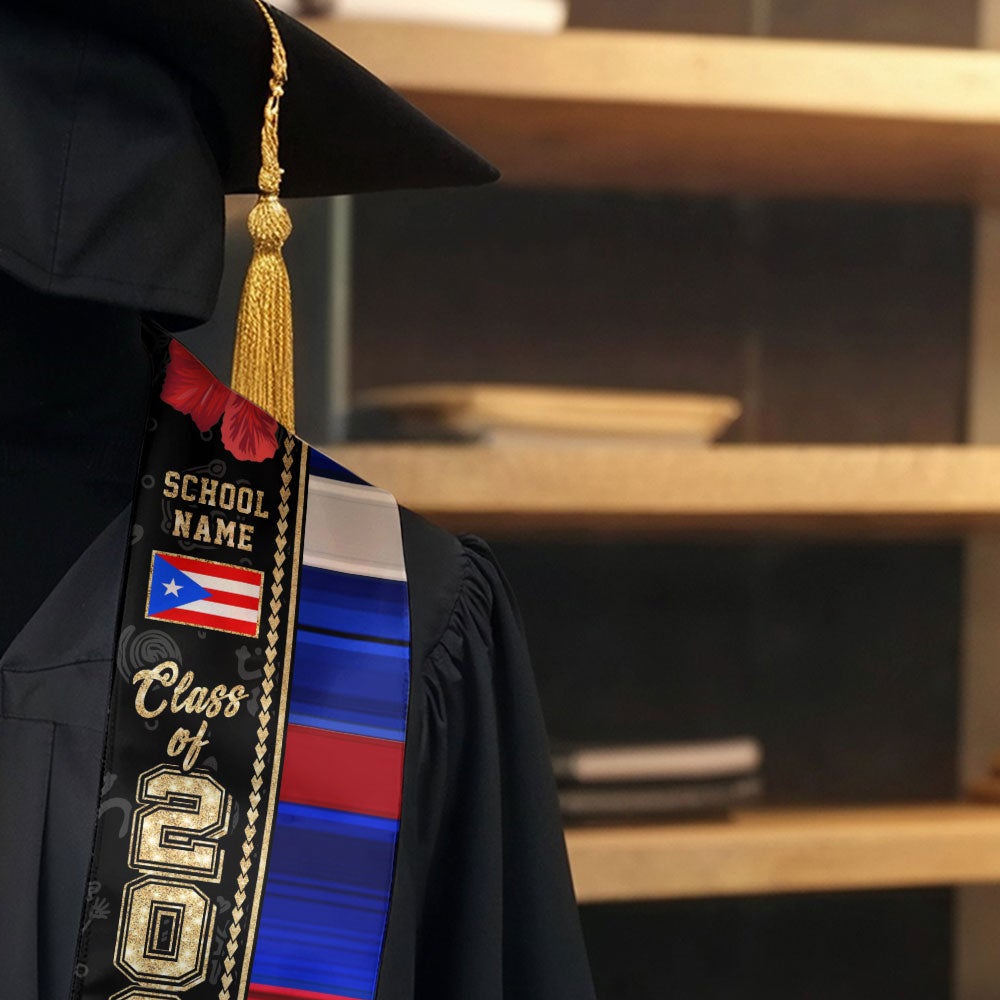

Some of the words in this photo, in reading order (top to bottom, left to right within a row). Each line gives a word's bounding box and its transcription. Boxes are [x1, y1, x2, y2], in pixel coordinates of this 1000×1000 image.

[163, 470, 269, 519] SCHOOL
[172, 509, 255, 552] NAME
[132, 660, 249, 719] Class
[166, 719, 209, 772] of
